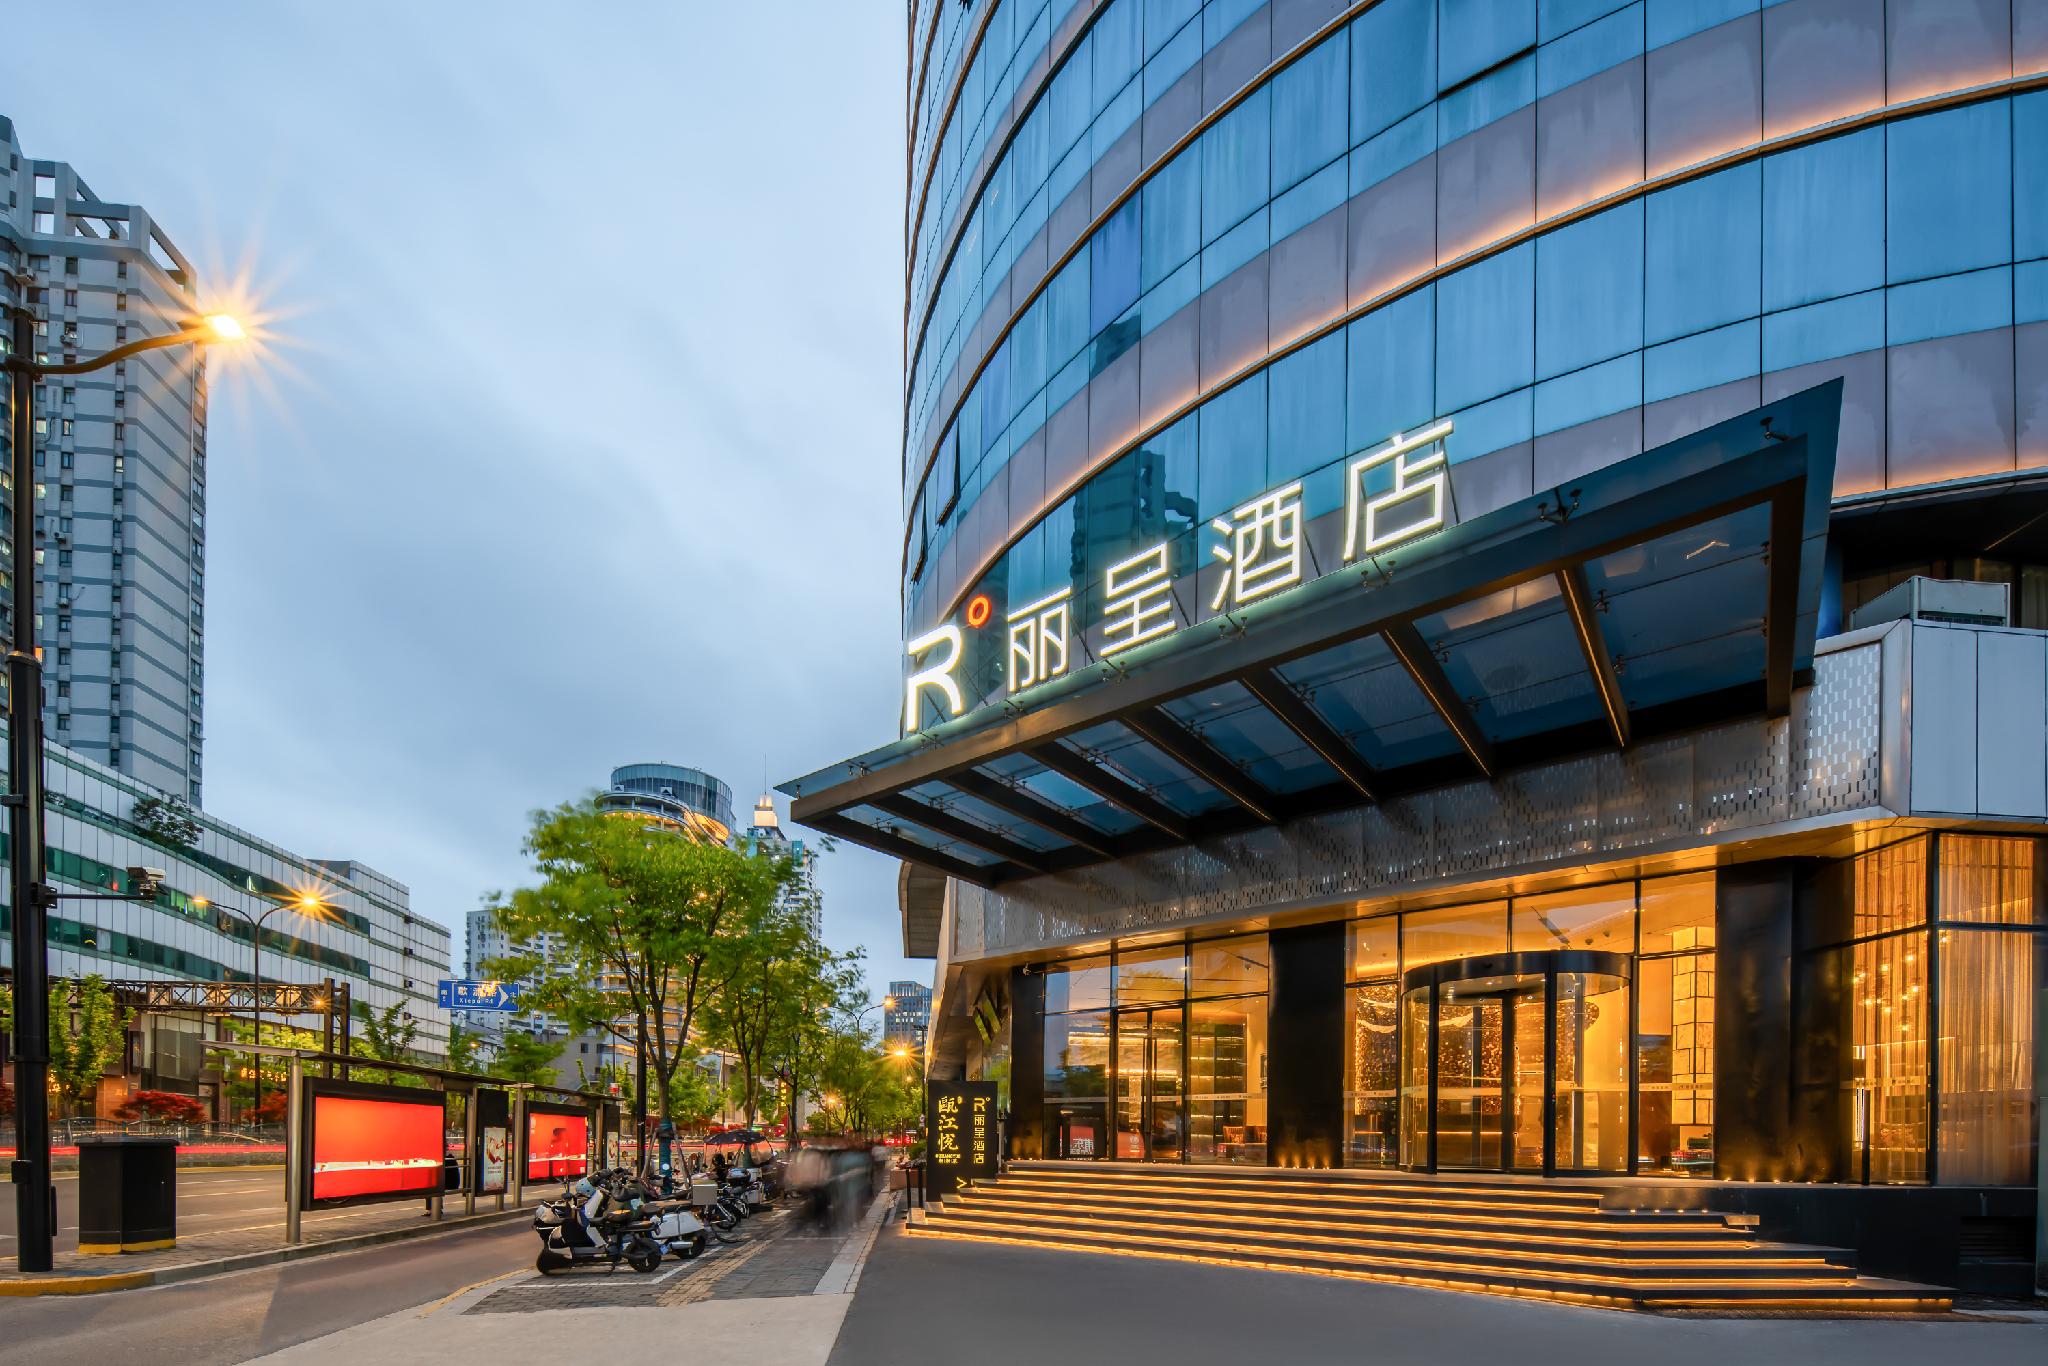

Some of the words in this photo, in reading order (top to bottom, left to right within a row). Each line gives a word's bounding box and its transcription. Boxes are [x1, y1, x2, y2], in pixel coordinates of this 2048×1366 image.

[1008, 419, 1454, 693] 丽呈酒店
[973, 1114, 985, 1164] 丽呈酒店
